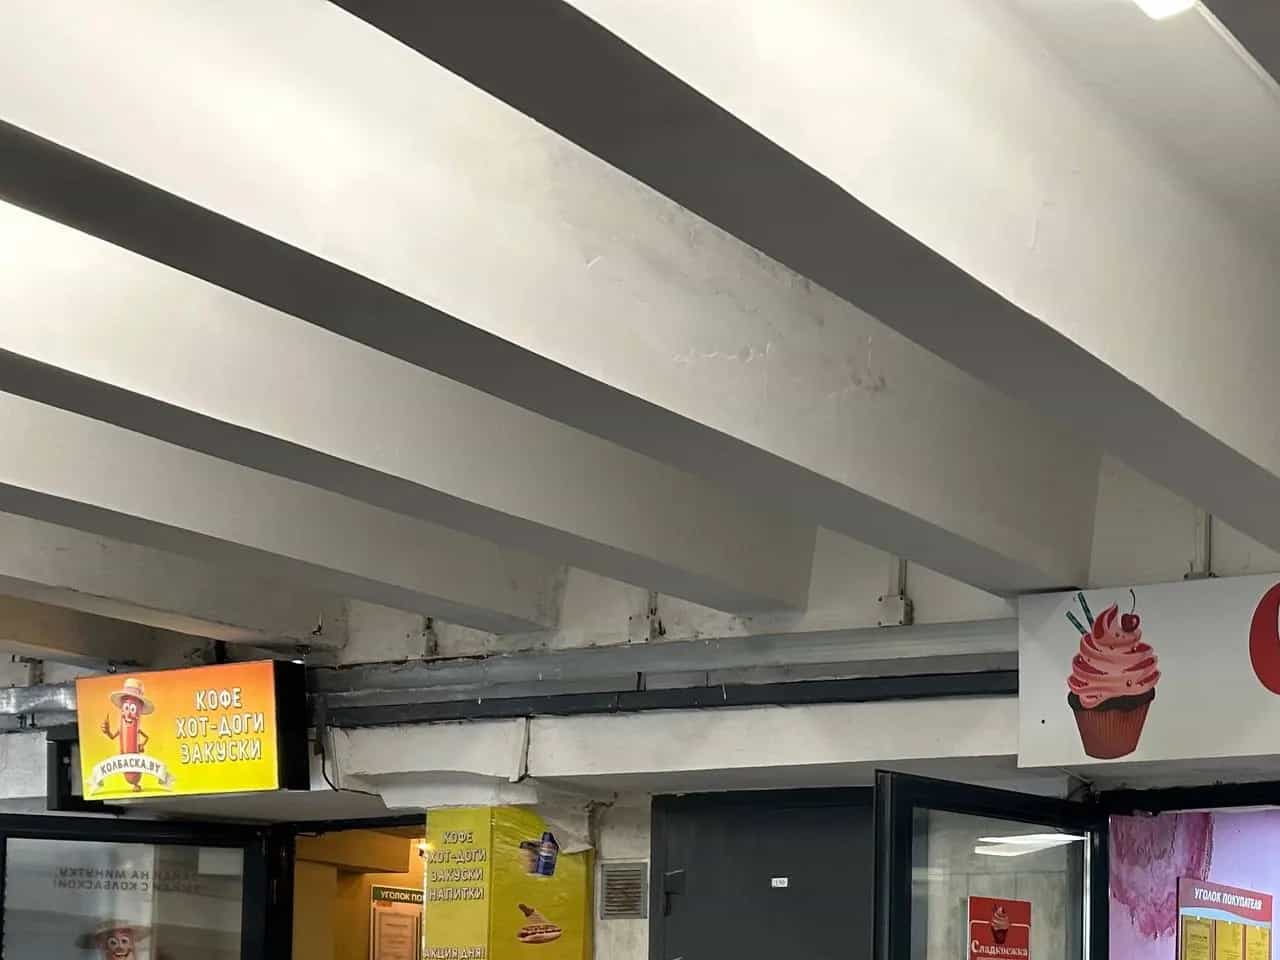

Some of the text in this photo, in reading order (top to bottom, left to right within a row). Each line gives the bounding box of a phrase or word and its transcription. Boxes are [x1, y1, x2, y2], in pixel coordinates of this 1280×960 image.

[195, 688, 242, 711] КОФЕ
[176, 713, 265, 738] ХОТ-ДОГИ
[181, 739, 262, 764] ЗАКУСКИ
[443, 832, 473, 844] КОФЕ
[431, 866, 484, 882] ЗАКУСКИ
[1194, 887, 1221, 903] УГОЛОК
